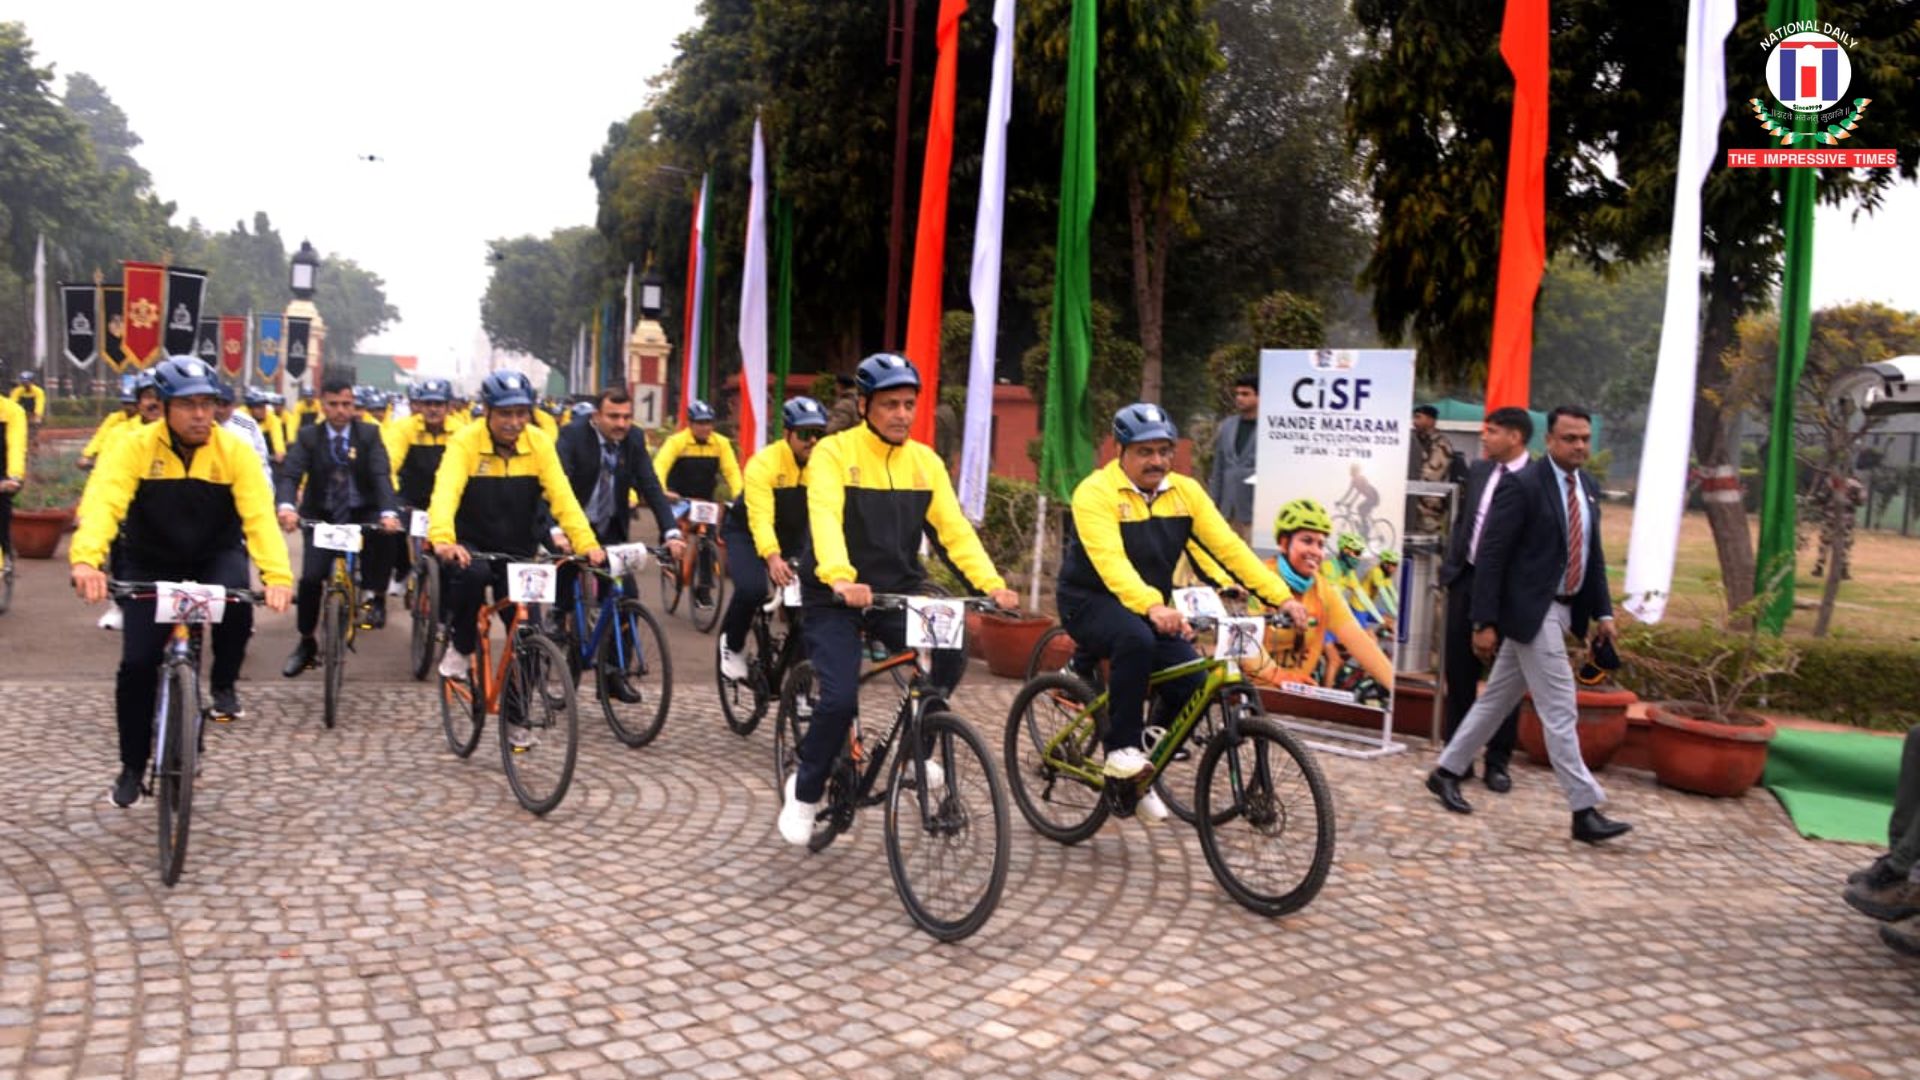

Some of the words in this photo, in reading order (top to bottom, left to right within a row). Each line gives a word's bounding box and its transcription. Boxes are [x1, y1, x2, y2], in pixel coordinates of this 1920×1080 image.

[642, 391, 655, 422] 1
[1267, 415, 1317, 430] VANDE
[1320, 417, 1399, 432] MATARAM
[1268, 431, 1311, 442] COASTAL
[1312, 432, 1371, 444] CYCLOTHON
